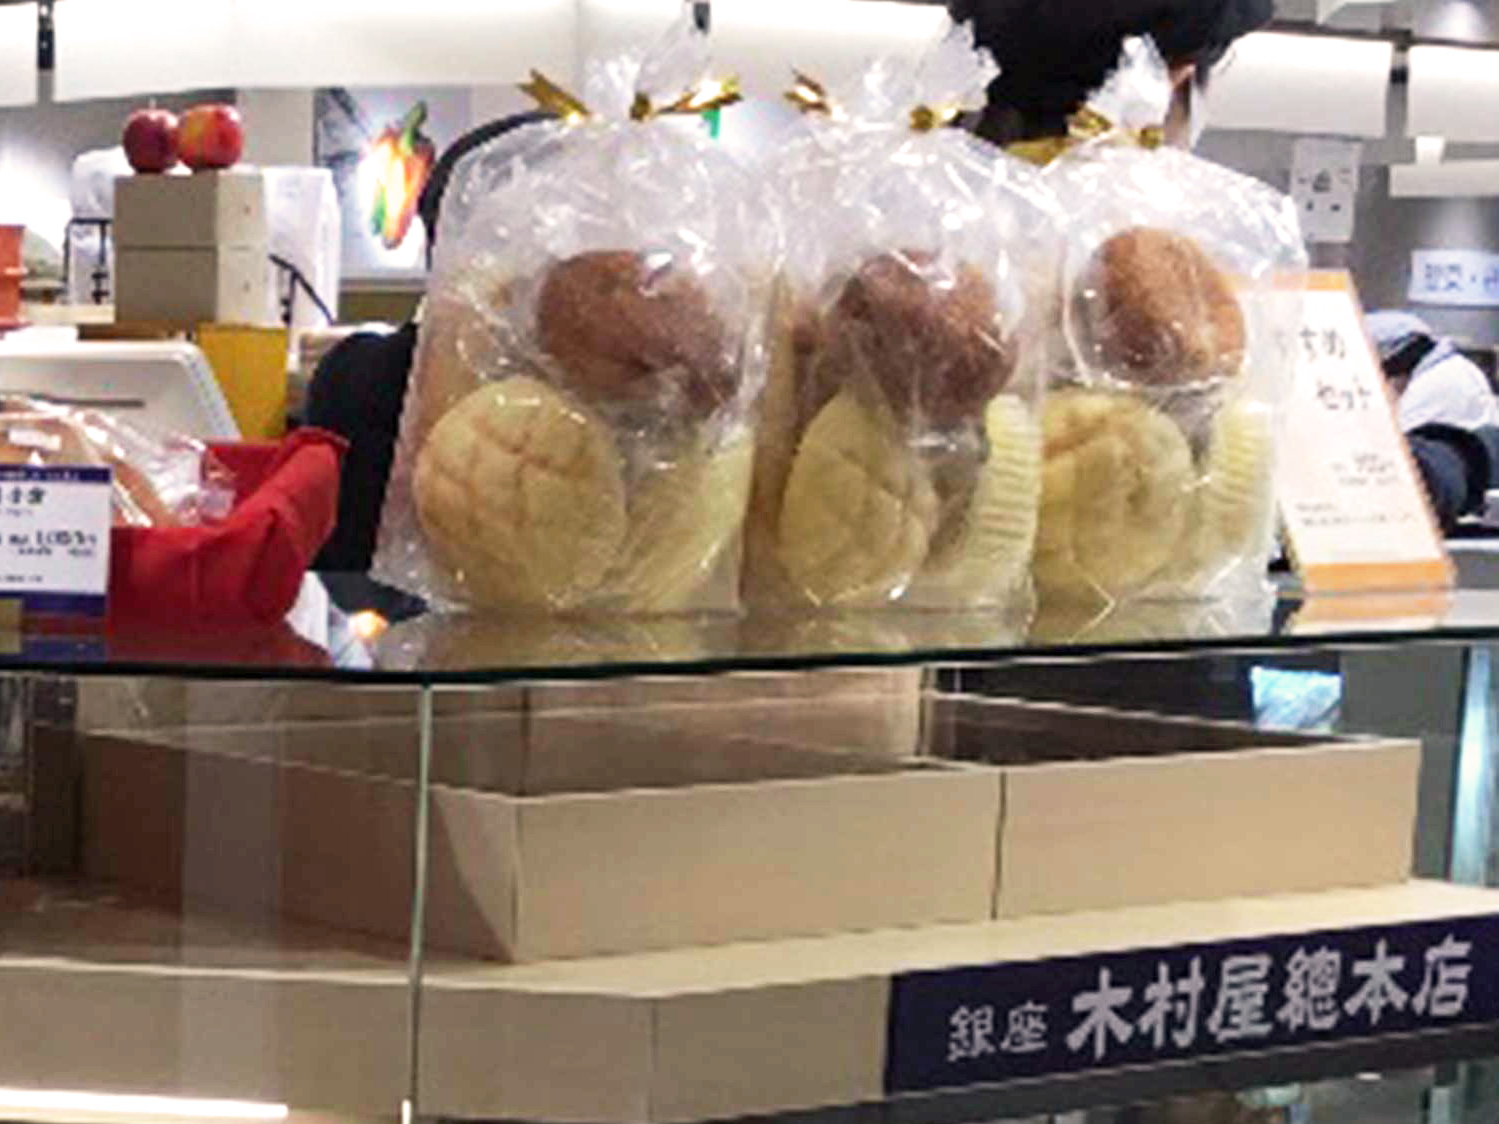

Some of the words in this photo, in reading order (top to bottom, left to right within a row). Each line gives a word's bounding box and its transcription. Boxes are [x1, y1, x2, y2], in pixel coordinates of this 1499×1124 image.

[946, 1001, 1051, 1063] 銀座
[1065, 933, 1474, 1060] 木村屋總本店
